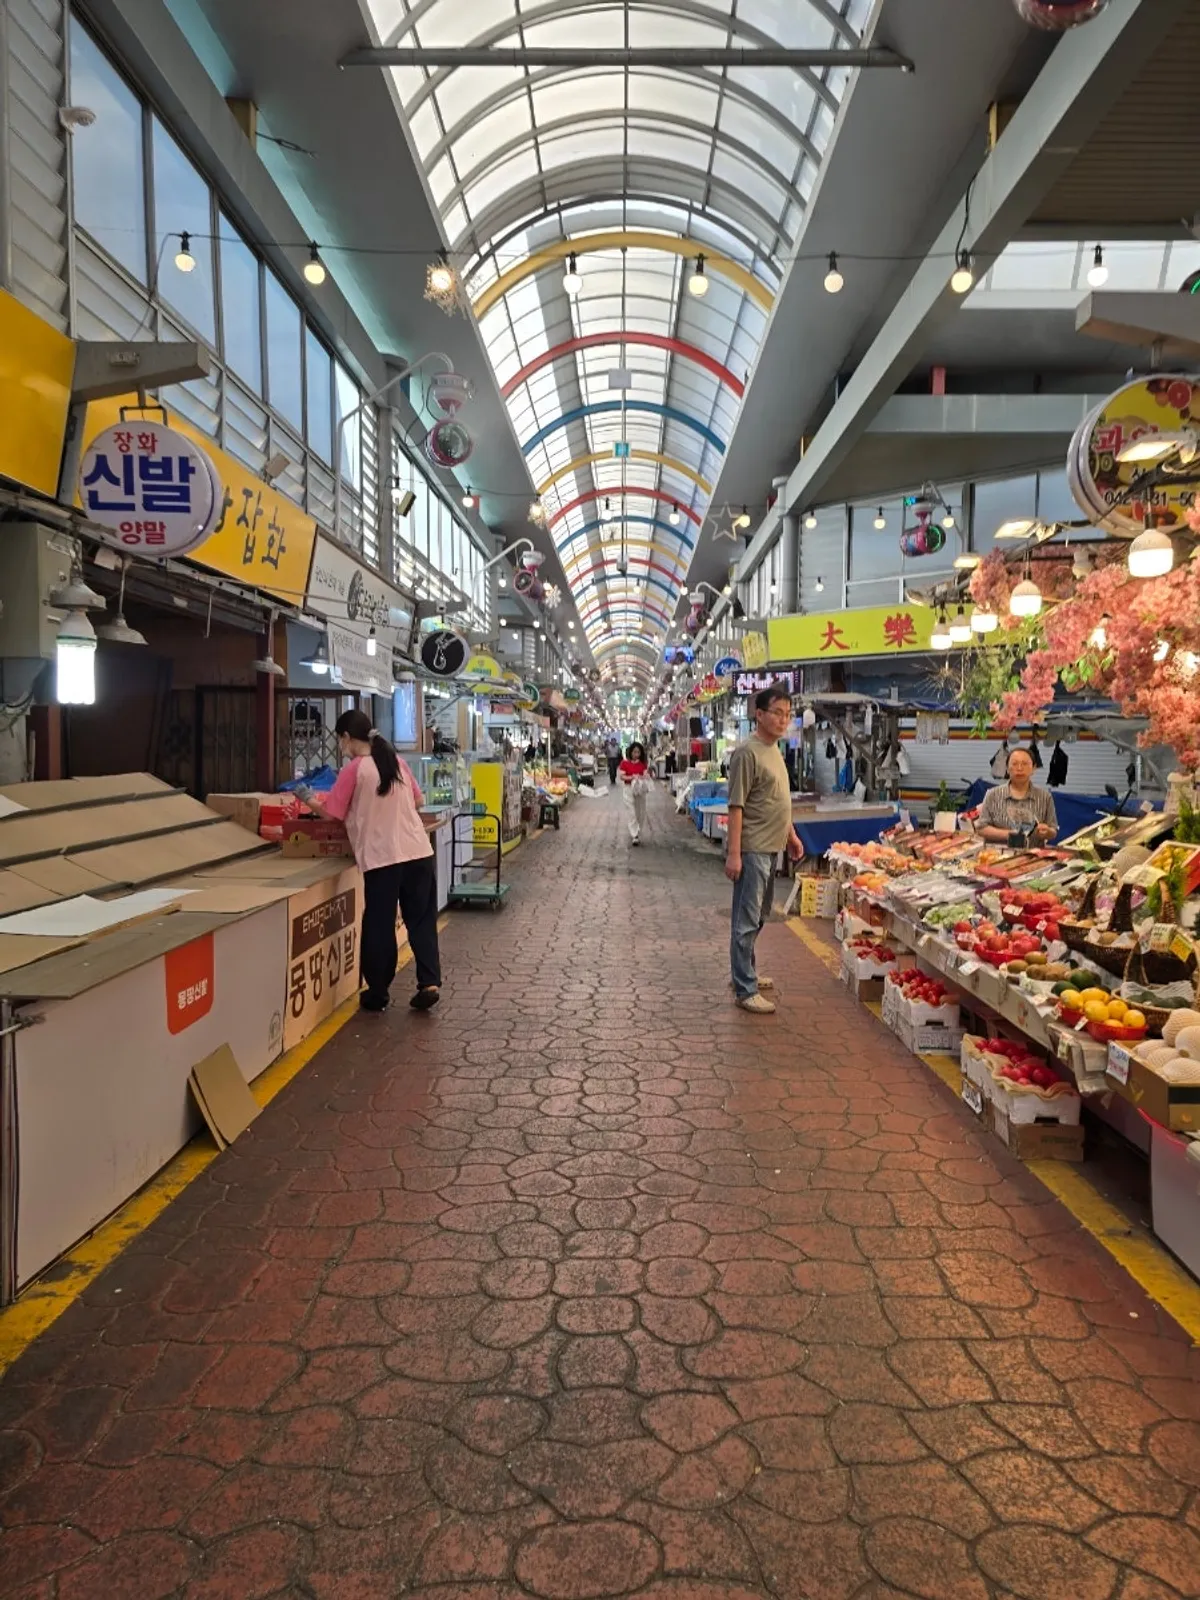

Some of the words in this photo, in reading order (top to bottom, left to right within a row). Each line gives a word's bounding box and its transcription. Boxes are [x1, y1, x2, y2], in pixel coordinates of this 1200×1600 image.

[113, 431, 158, 453] 장화
[83, 454, 196, 514] 신발
[119, 520, 167, 545] 양말
[290, 927, 357, 1018] 몽땅신발
